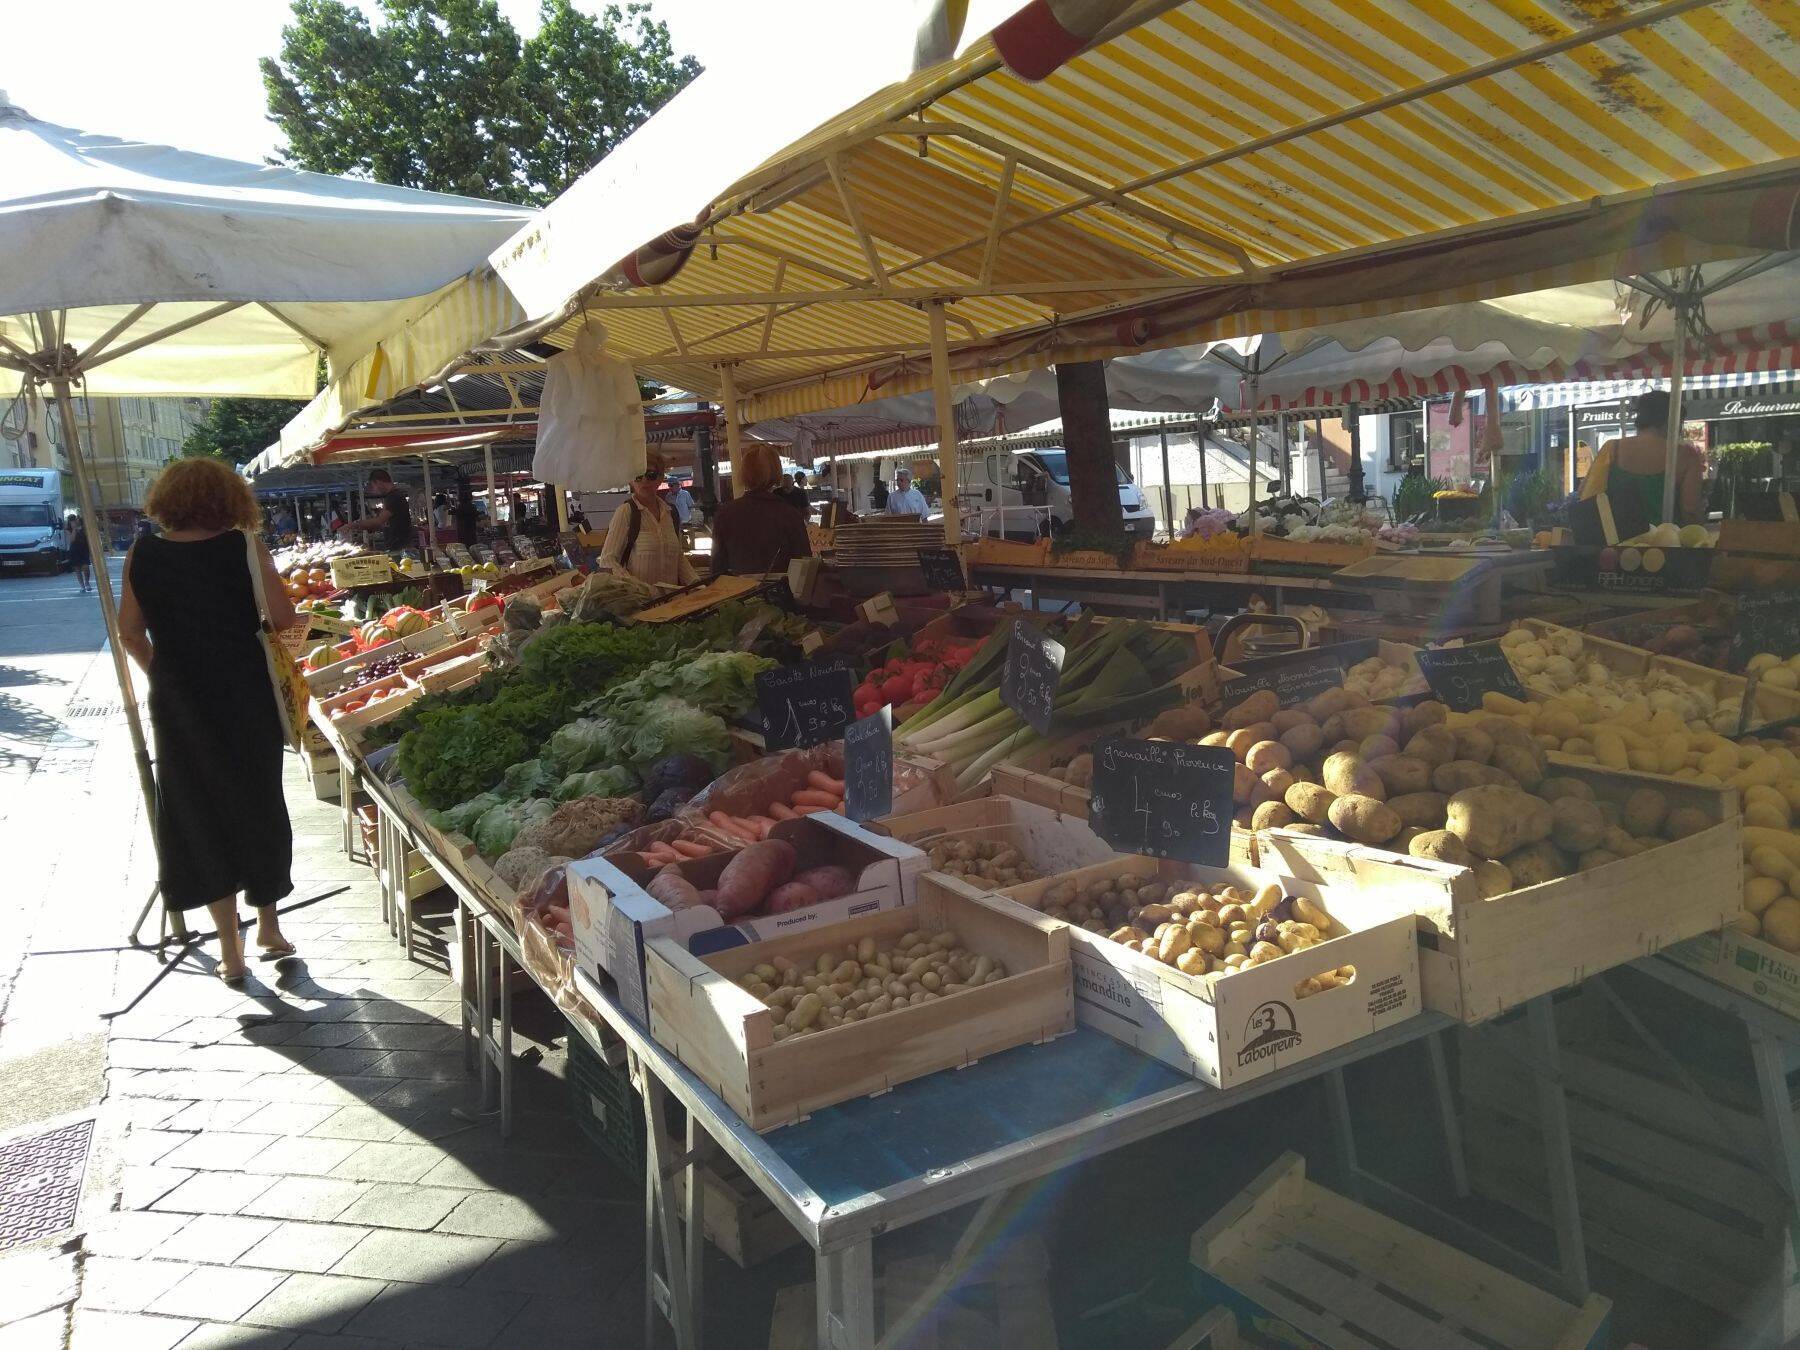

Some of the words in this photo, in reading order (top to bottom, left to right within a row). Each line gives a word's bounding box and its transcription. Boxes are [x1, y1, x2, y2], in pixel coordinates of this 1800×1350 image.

[1582, 411, 1614, 422] Fruits
[1155, 556, 1184, 567] Saveurs
[1187, 555, 1197, 566] du
[776, 914, 807, 928] Produced
[808, 913, 818, 921] by:
[1262, 1008, 1275, 1031] 3
[1237, 1031, 1302, 1068] Laboureurs
